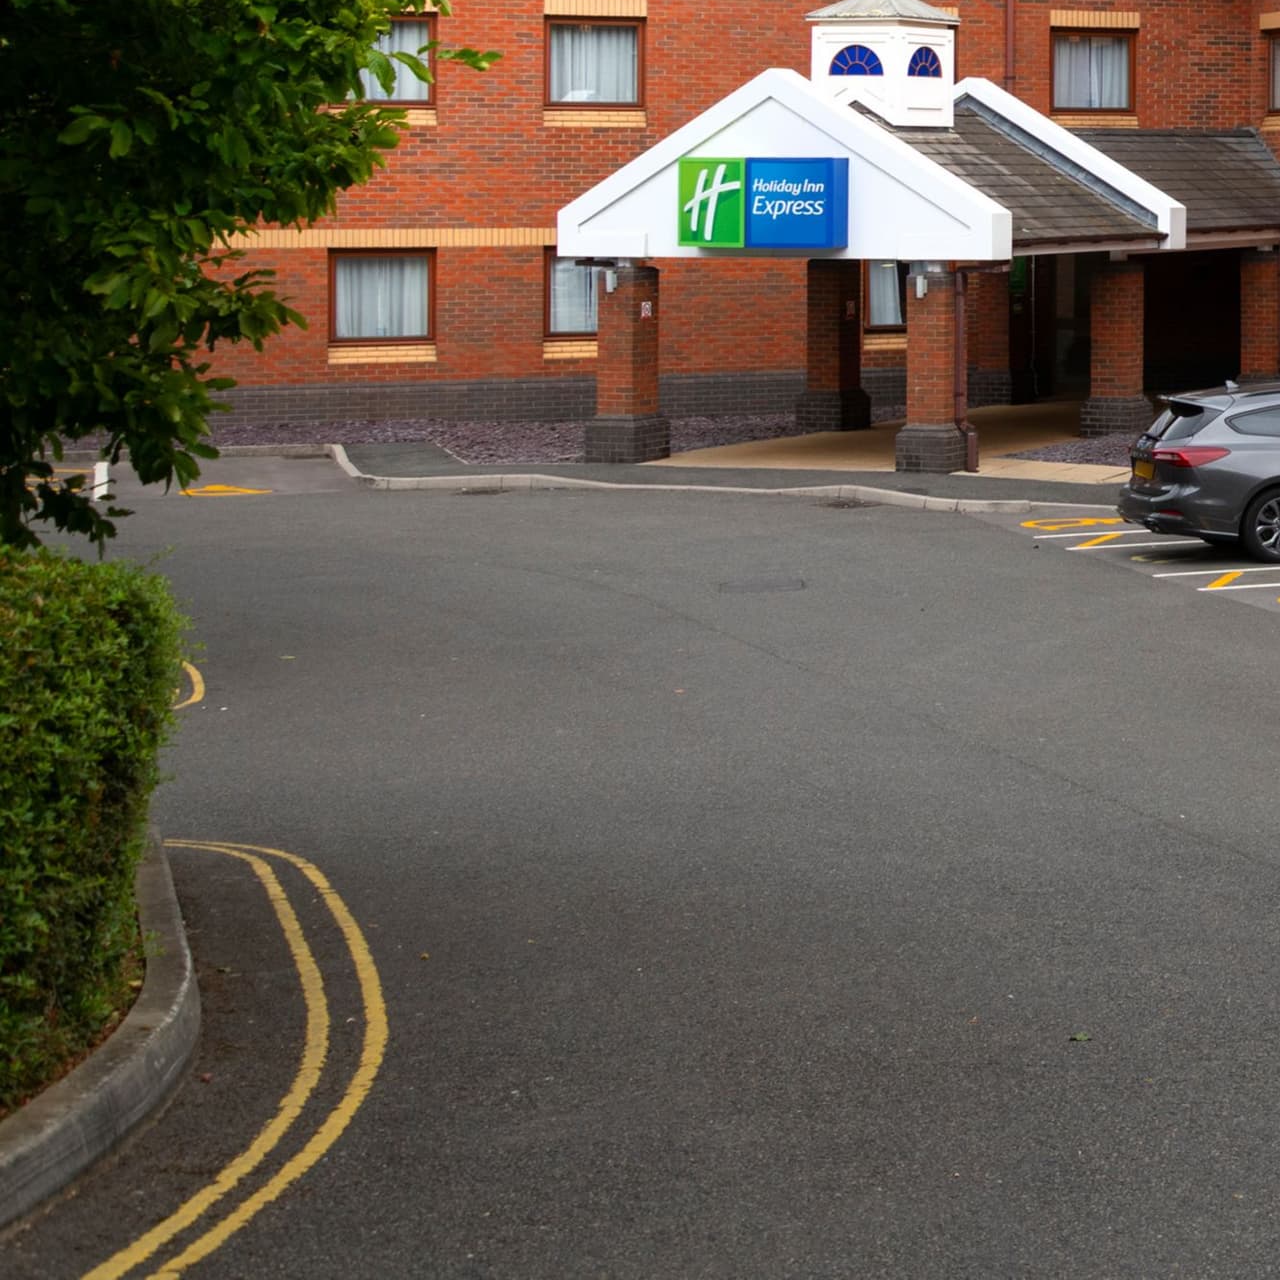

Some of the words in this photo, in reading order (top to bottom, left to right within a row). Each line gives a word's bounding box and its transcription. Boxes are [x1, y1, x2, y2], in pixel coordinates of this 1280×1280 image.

[752, 178, 801, 195] Holiday
[803, 179, 824, 192] Inn
[752, 195, 824, 220] Express
